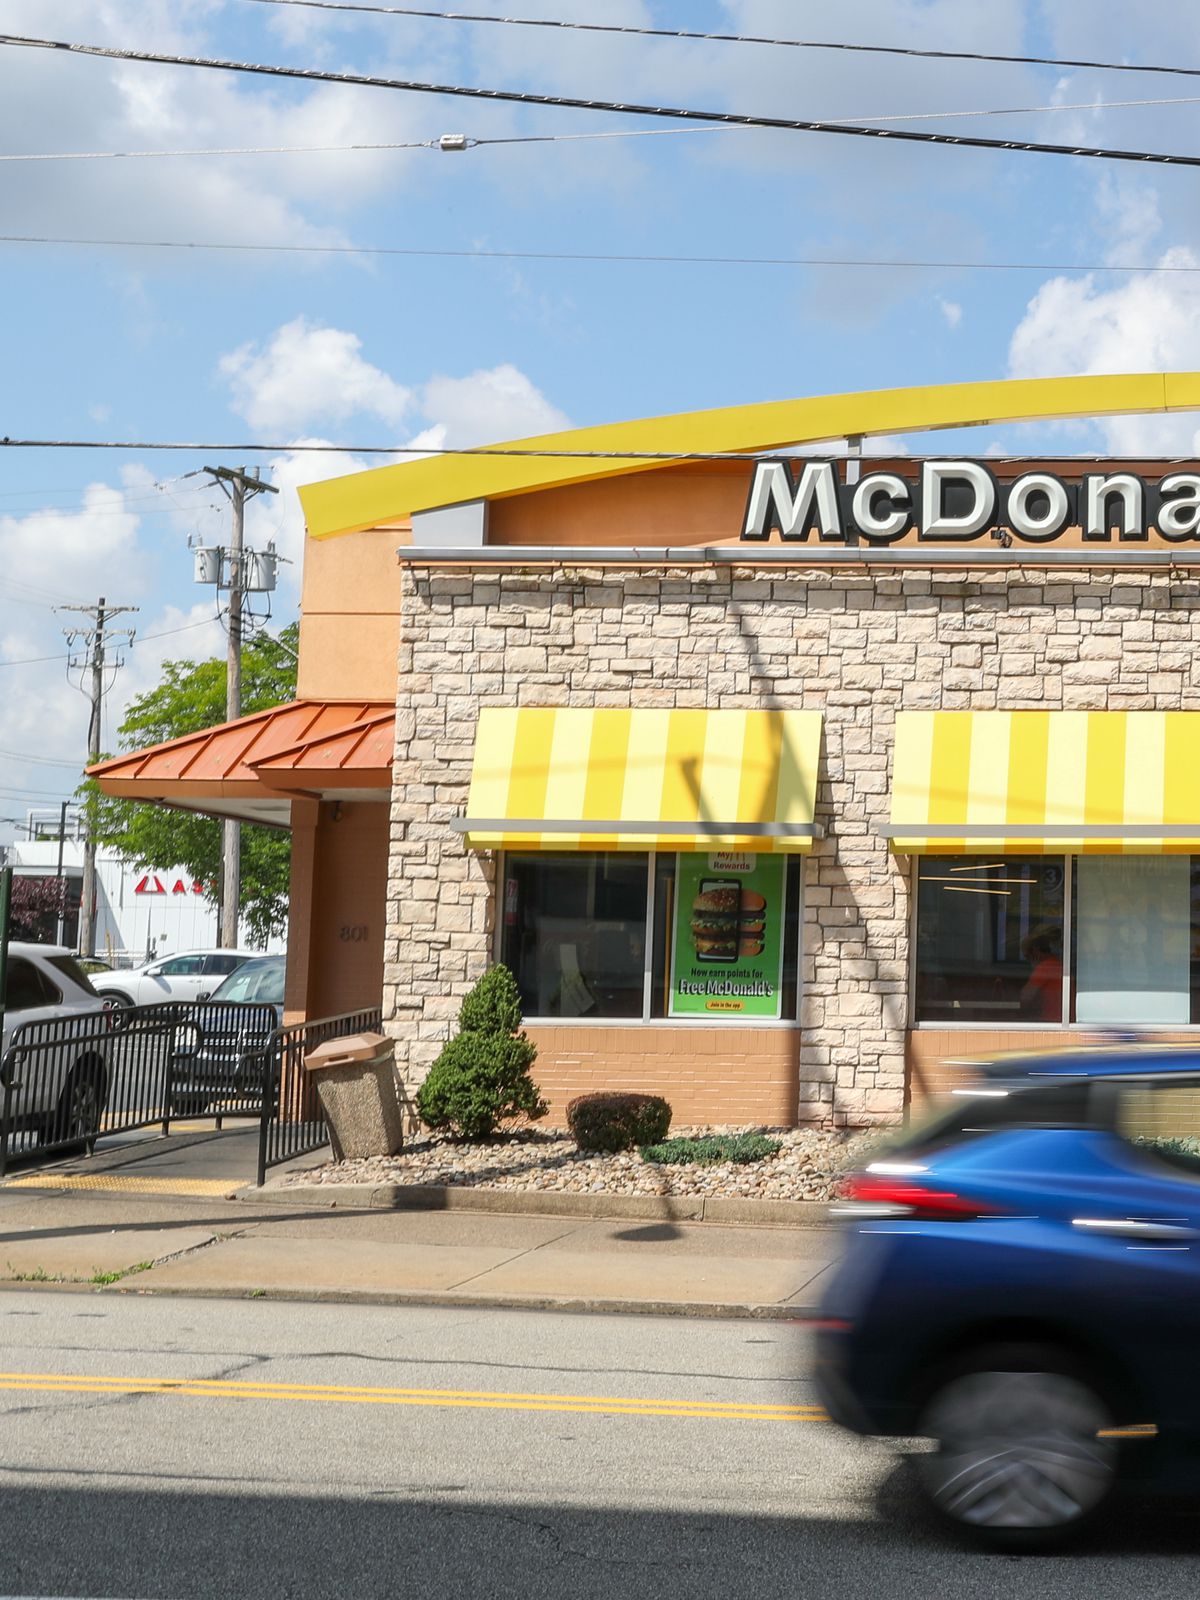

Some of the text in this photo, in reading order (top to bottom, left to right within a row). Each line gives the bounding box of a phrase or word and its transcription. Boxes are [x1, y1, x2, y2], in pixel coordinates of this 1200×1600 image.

[713, 861, 750, 870] Rewards
[691, 968, 763, 979] Now earn points for
[679, 979, 774, 997] Free McDonald's
